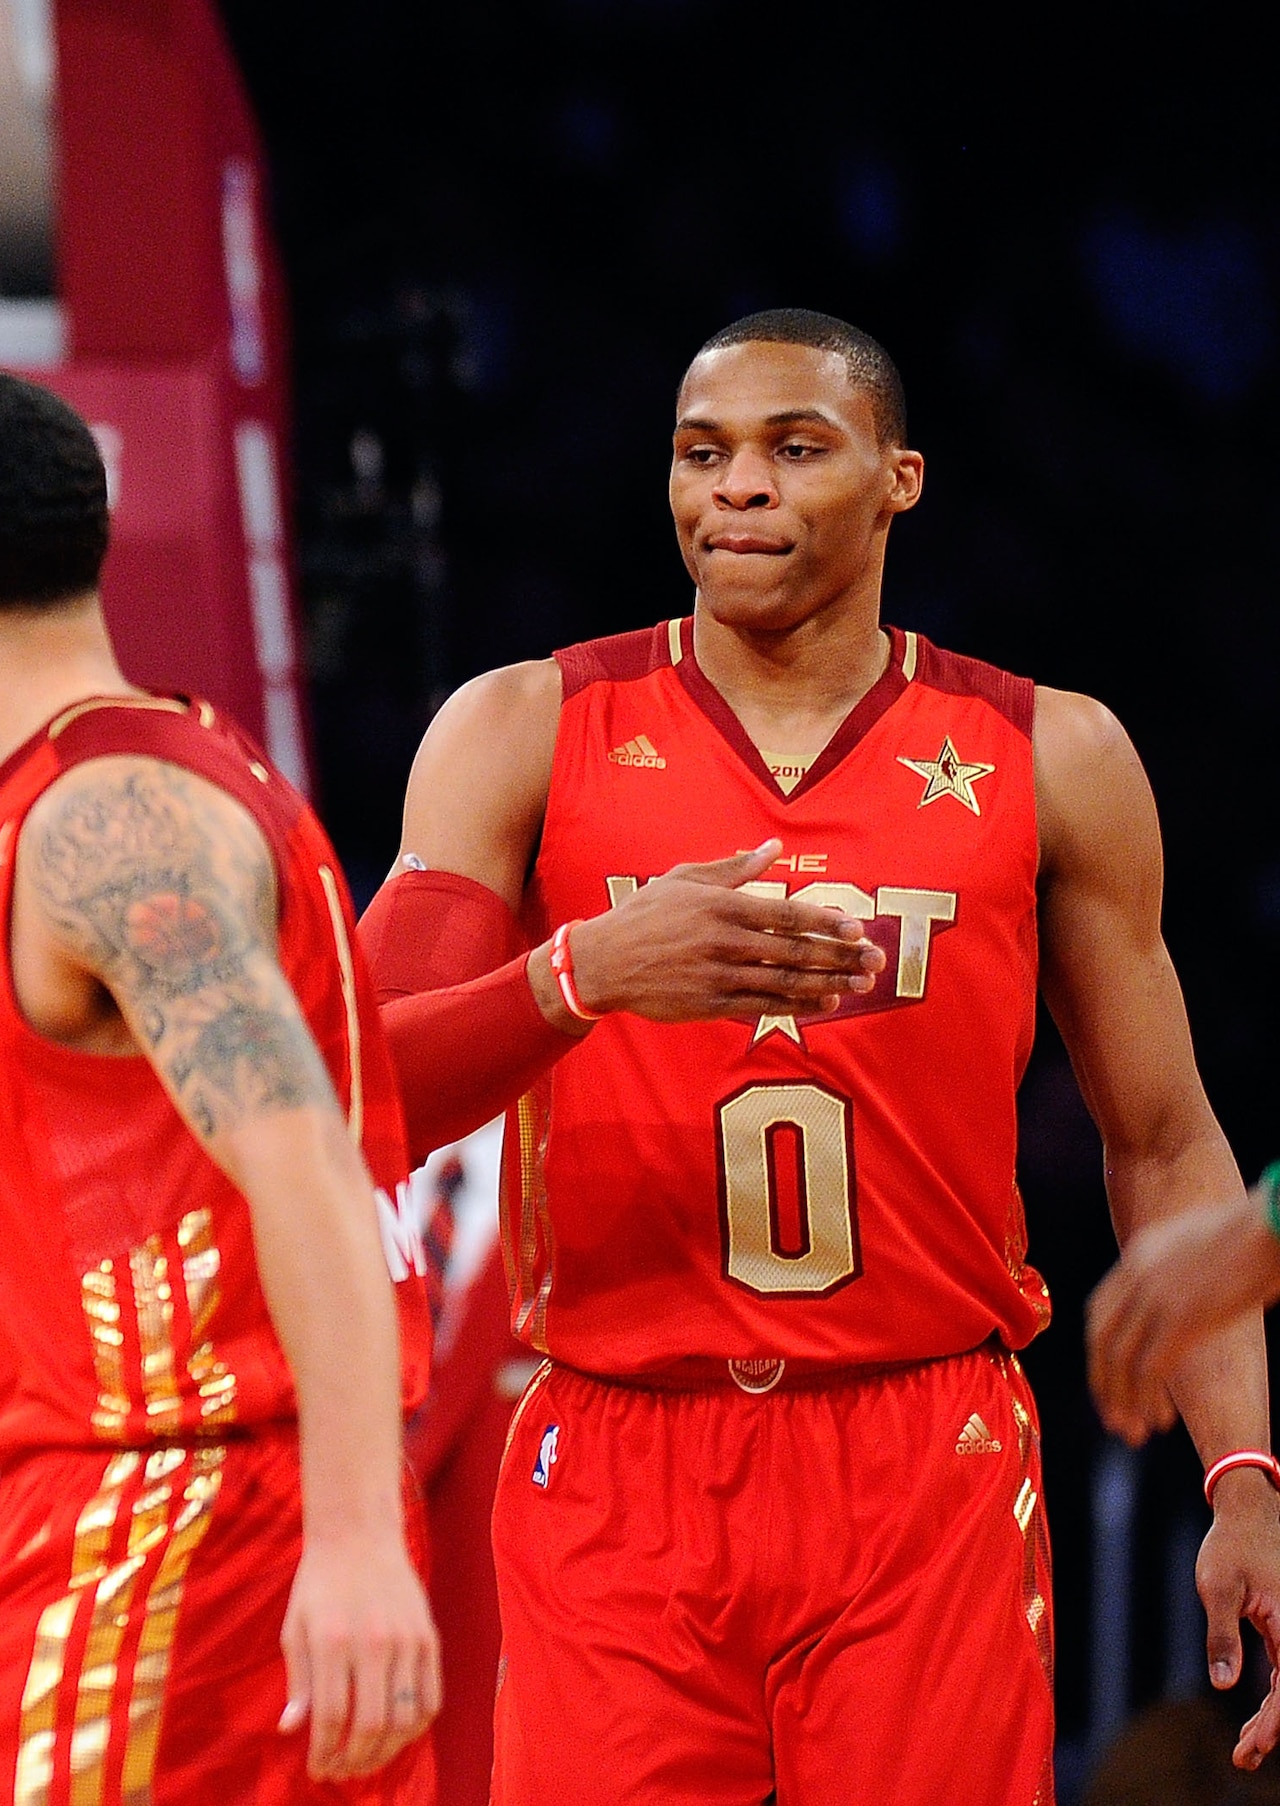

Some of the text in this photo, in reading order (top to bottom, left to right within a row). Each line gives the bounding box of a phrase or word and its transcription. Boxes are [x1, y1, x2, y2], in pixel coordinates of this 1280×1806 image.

[607, 752, 666, 769] adidas
[714, 1078, 863, 1301] 0
[955, 1439, 1002, 1455] adidas
